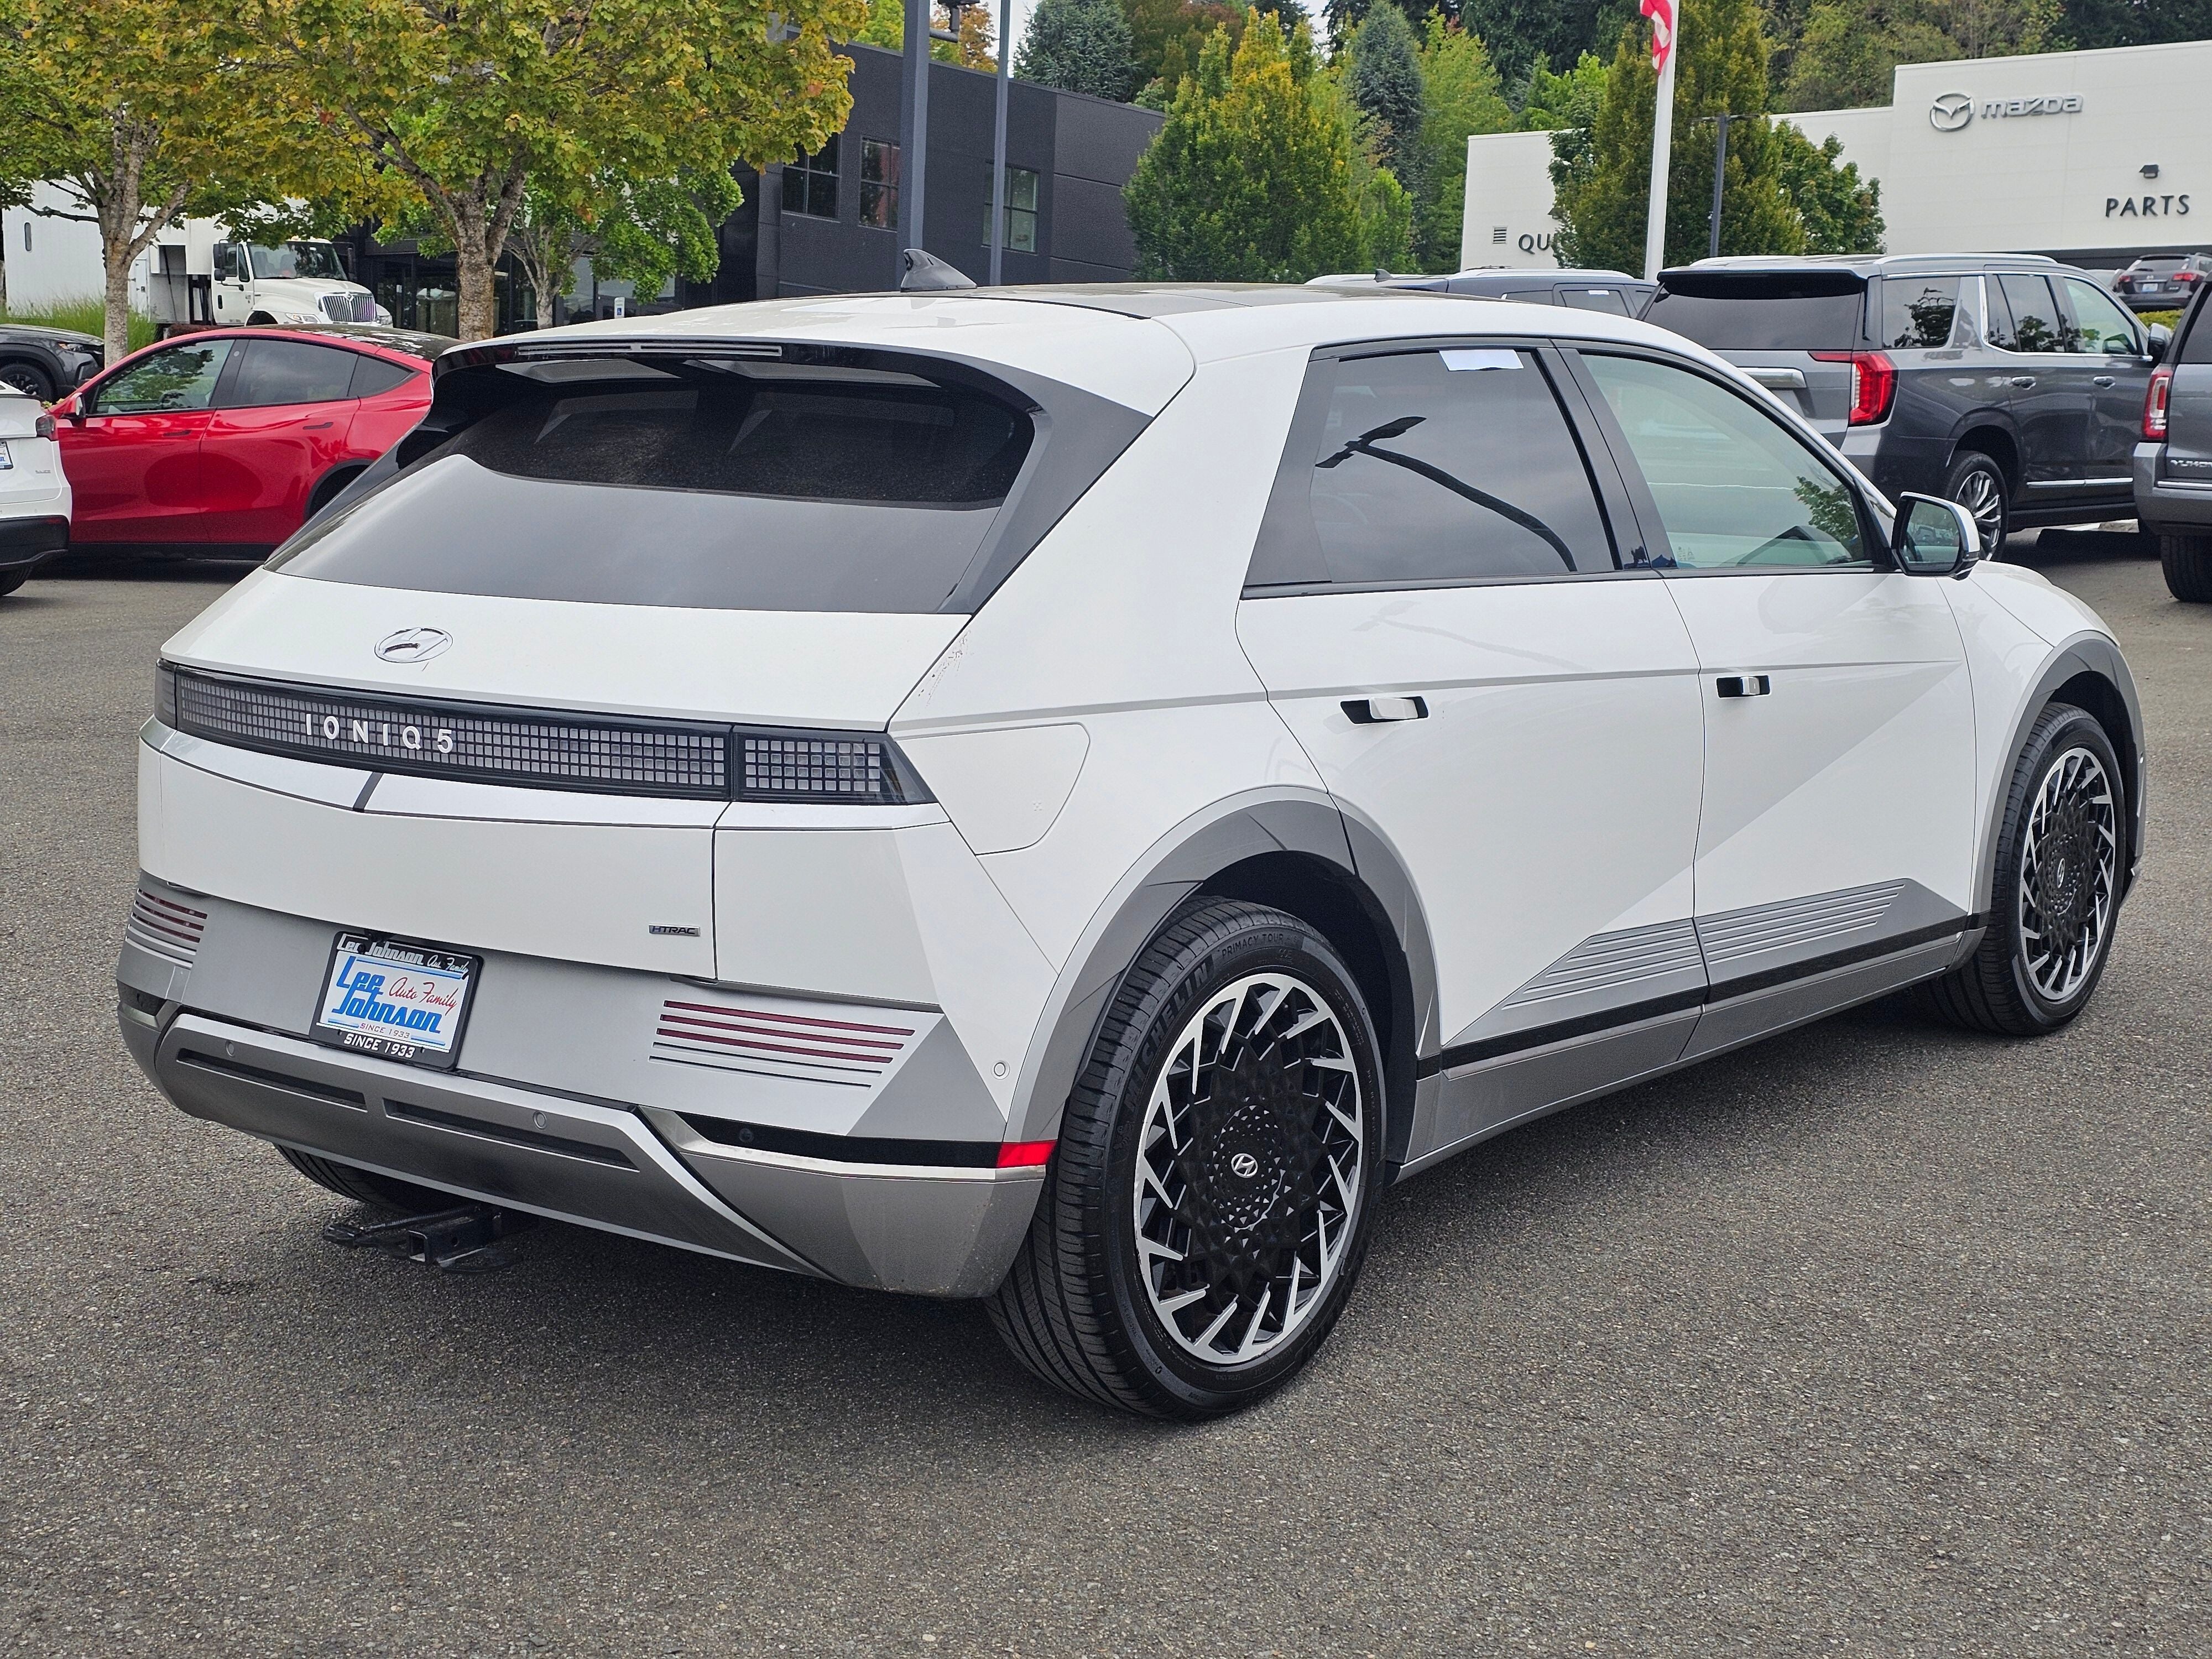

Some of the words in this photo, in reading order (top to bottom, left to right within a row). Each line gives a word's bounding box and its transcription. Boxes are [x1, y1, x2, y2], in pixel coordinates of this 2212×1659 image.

[1981, 95, 2083, 118] mazda
[2105, 194, 2190, 217] PARTS
[306, 713, 421, 750] IONIQ
[437, 728, 453, 753] 5
[652, 925, 695, 935] HTRAC
[1222, 935, 1259, 957] PRIMACY
[1262, 933, 1284, 942] TOUR
[365, 941, 424, 966] Johnson
[427, 955, 442, 969] Aut
[445, 957, 469, 978] Family
[336, 956, 386, 995] Lee
[389, 977, 418, 1000] Auto
[419, 982, 459, 1016] Family
[332, 990, 442, 1034] Johnson
[359, 1022, 385, 1033] SINCE
[389, 1029, 410, 1039] 1933
[1124, 962, 1209, 1113] MICHELIN
[343, 1033, 382, 1051] SINCE
[385, 1041, 415, 1058] 1933
